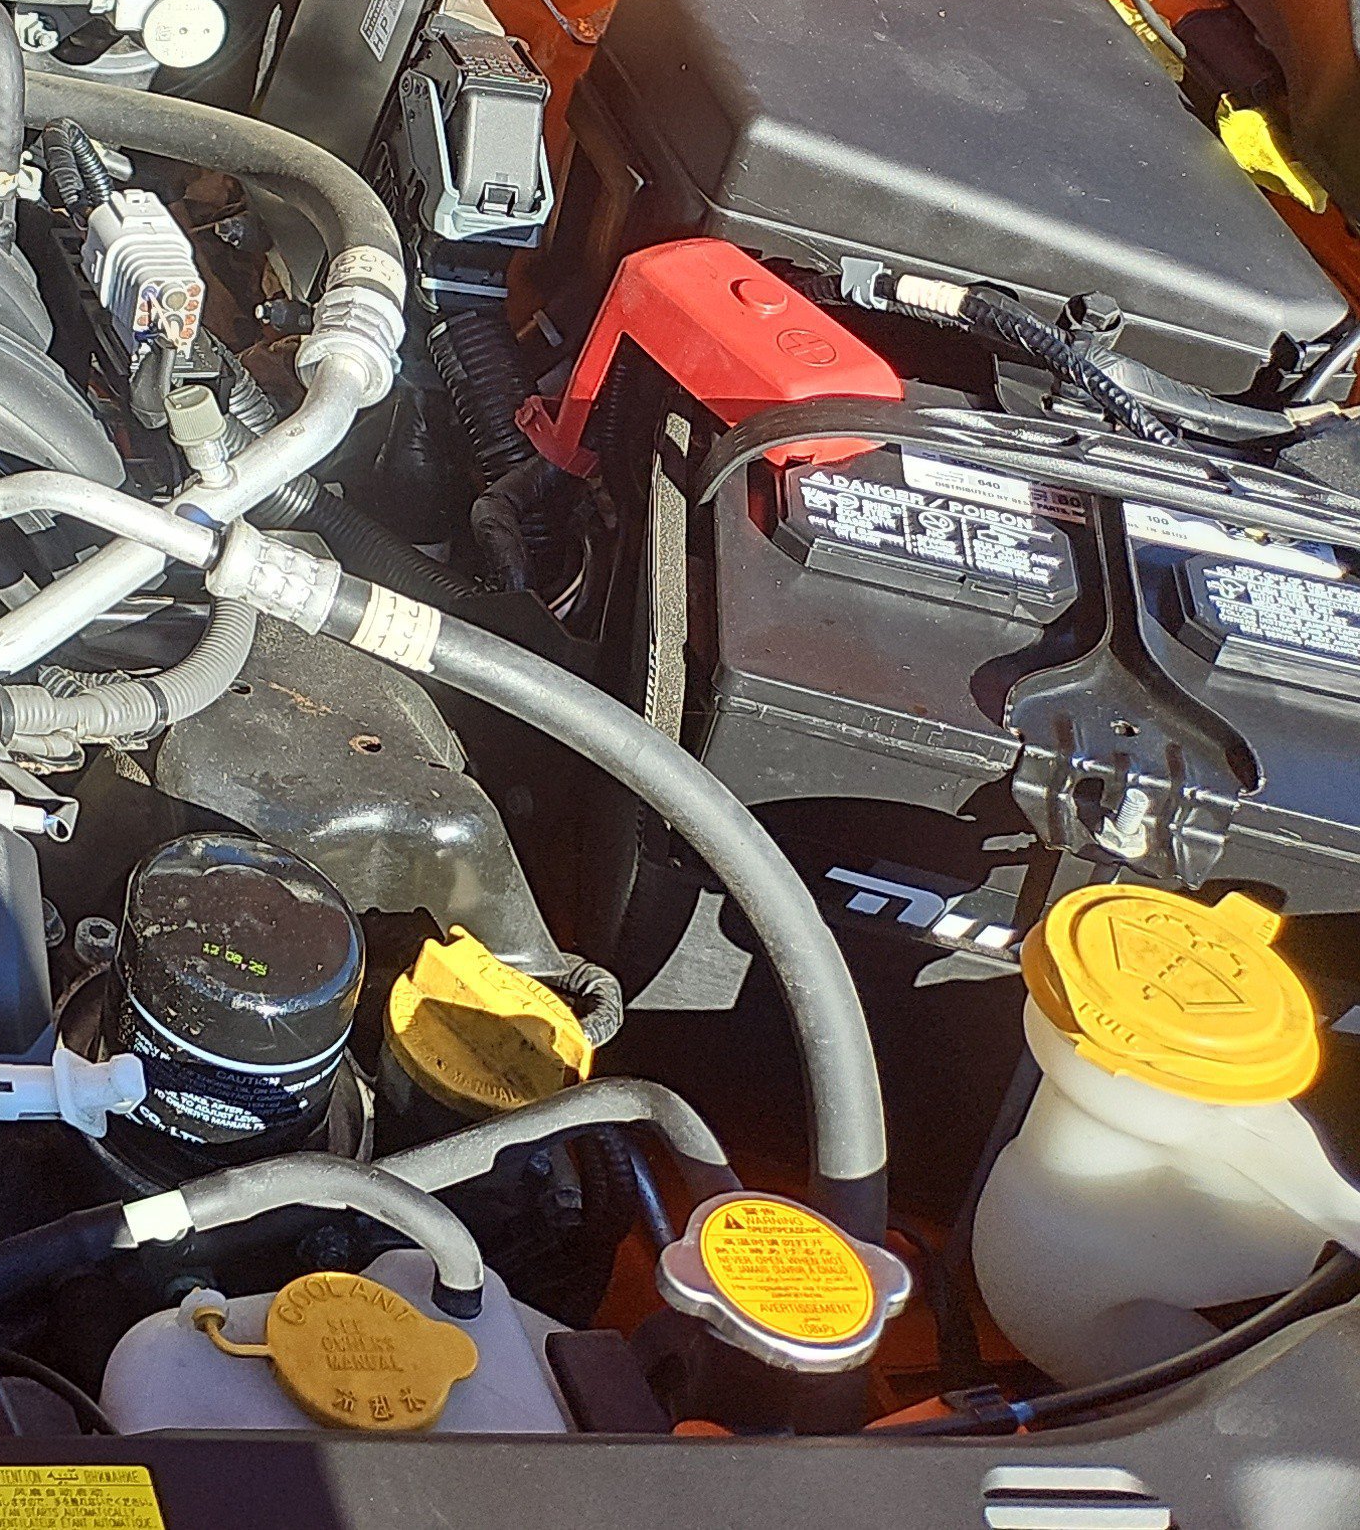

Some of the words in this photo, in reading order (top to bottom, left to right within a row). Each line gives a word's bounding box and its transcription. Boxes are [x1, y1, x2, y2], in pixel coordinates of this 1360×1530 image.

[831, 474, 925, 506] DANGER
[949, 499, 1032, 530] POISON
[214, 1069, 281, 1088] CAUTION
[743, 1216, 804, 1226] WARNING
[277, 1274, 417, 1327] COOLANT
[760, 1303, 853, 1315] AVERTISSEMENT
